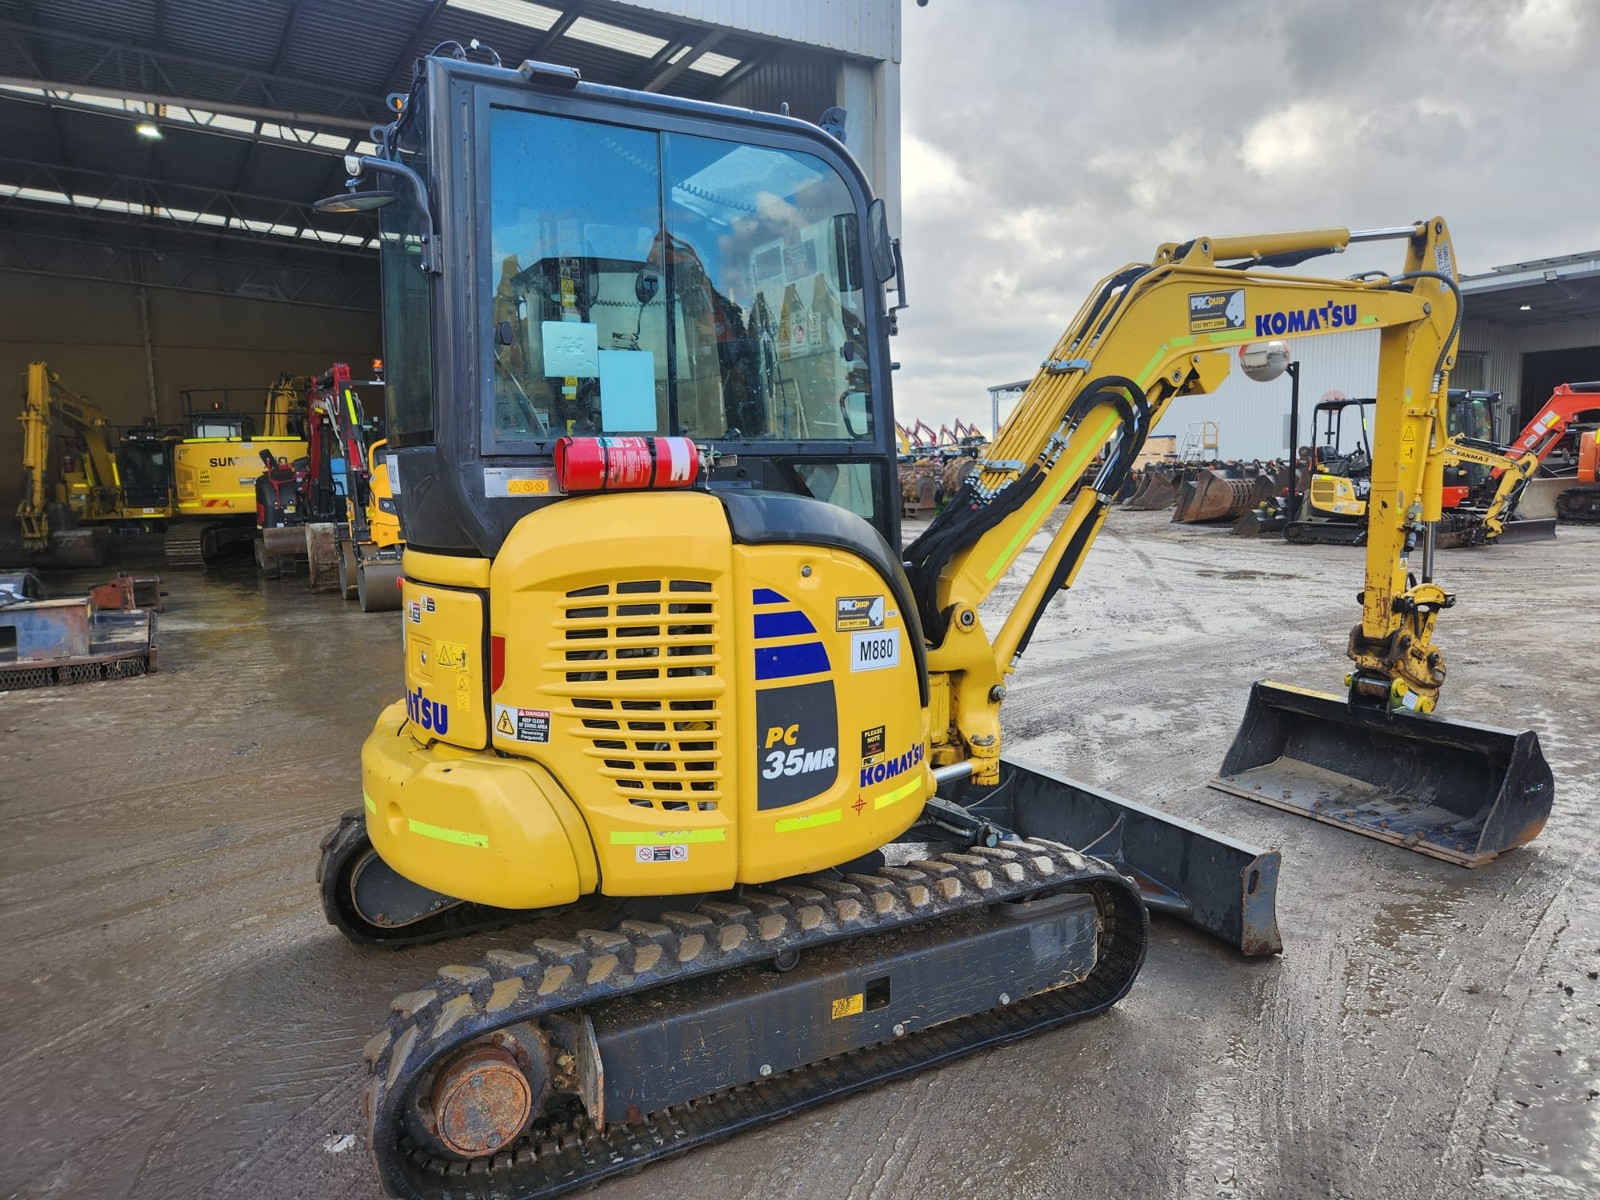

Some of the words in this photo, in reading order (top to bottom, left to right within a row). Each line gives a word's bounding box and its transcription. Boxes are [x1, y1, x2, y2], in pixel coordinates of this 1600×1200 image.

[1255, 300, 1357, 337] KOMATSU
[860, 638, 893, 661] M880
[765, 724, 799, 749] PC
[864, 728, 883, 738] PLEASE
[866, 735, 881, 743] NOTE
[762, 747, 836, 780] 35MR
[860, 741, 925, 788] KOMATSU
